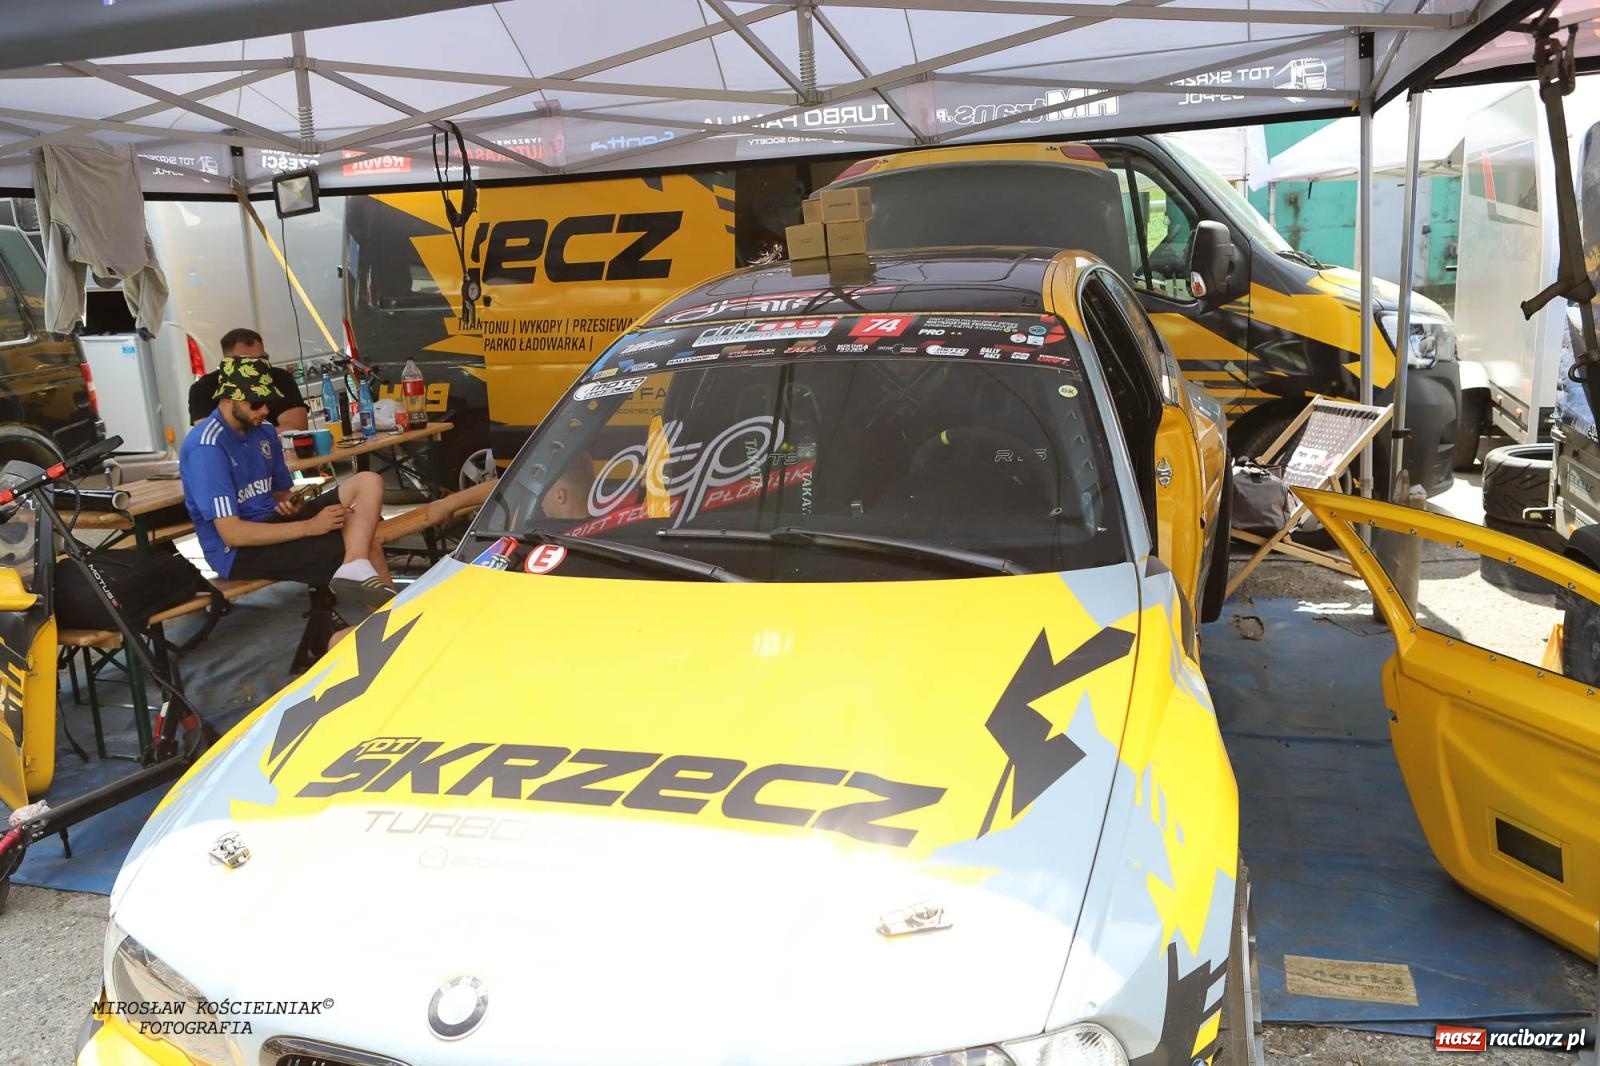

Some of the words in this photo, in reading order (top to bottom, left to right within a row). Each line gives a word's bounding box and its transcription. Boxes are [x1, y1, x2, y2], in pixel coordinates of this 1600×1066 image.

[519, 319, 563, 334] WYKOPY
[862, 318, 903, 334] 74
[918, 328, 946, 336] PRO
[484, 338, 517, 352] PARKO
[519, 336, 586, 351] ŁADOWARKA
[237, 477, 273, 504] SAMSU
[535, 545, 560, 567] E
[364, 809, 529, 842] TURBO
